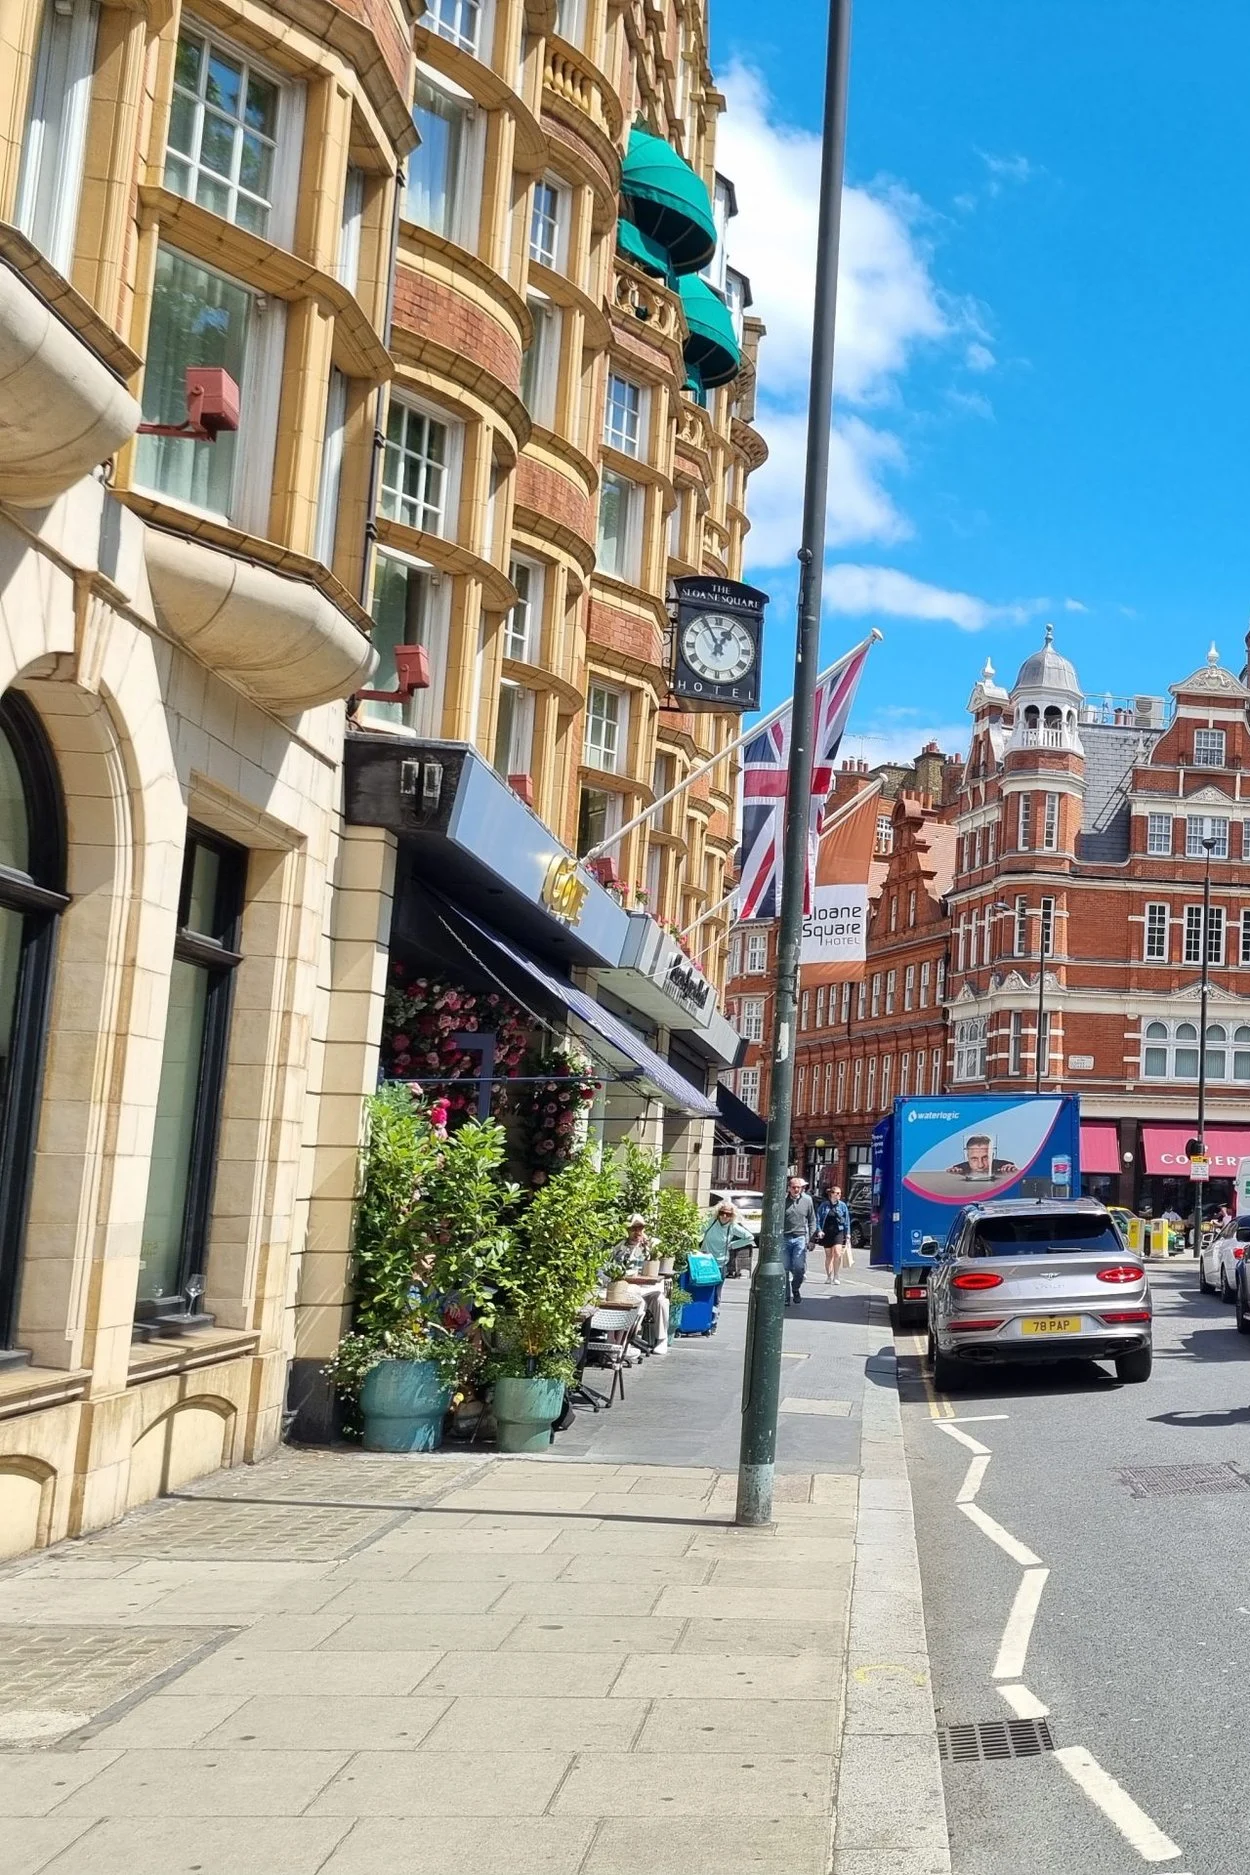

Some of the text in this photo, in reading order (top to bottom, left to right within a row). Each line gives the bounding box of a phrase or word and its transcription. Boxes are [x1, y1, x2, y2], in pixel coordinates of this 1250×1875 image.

[711, 584, 732, 595] THE
[682, 588, 760, 609] SLOANE SQUARE
[678, 680, 754, 700] HOTEL
[802, 922, 861, 946] Square
[825, 937, 860, 946] HOTEL
[917, 1110, 960, 1121] waterlogic
[1160, 1153, 1247, 1166] COER
[1033, 1320, 1070, 1332] 78 PAP
